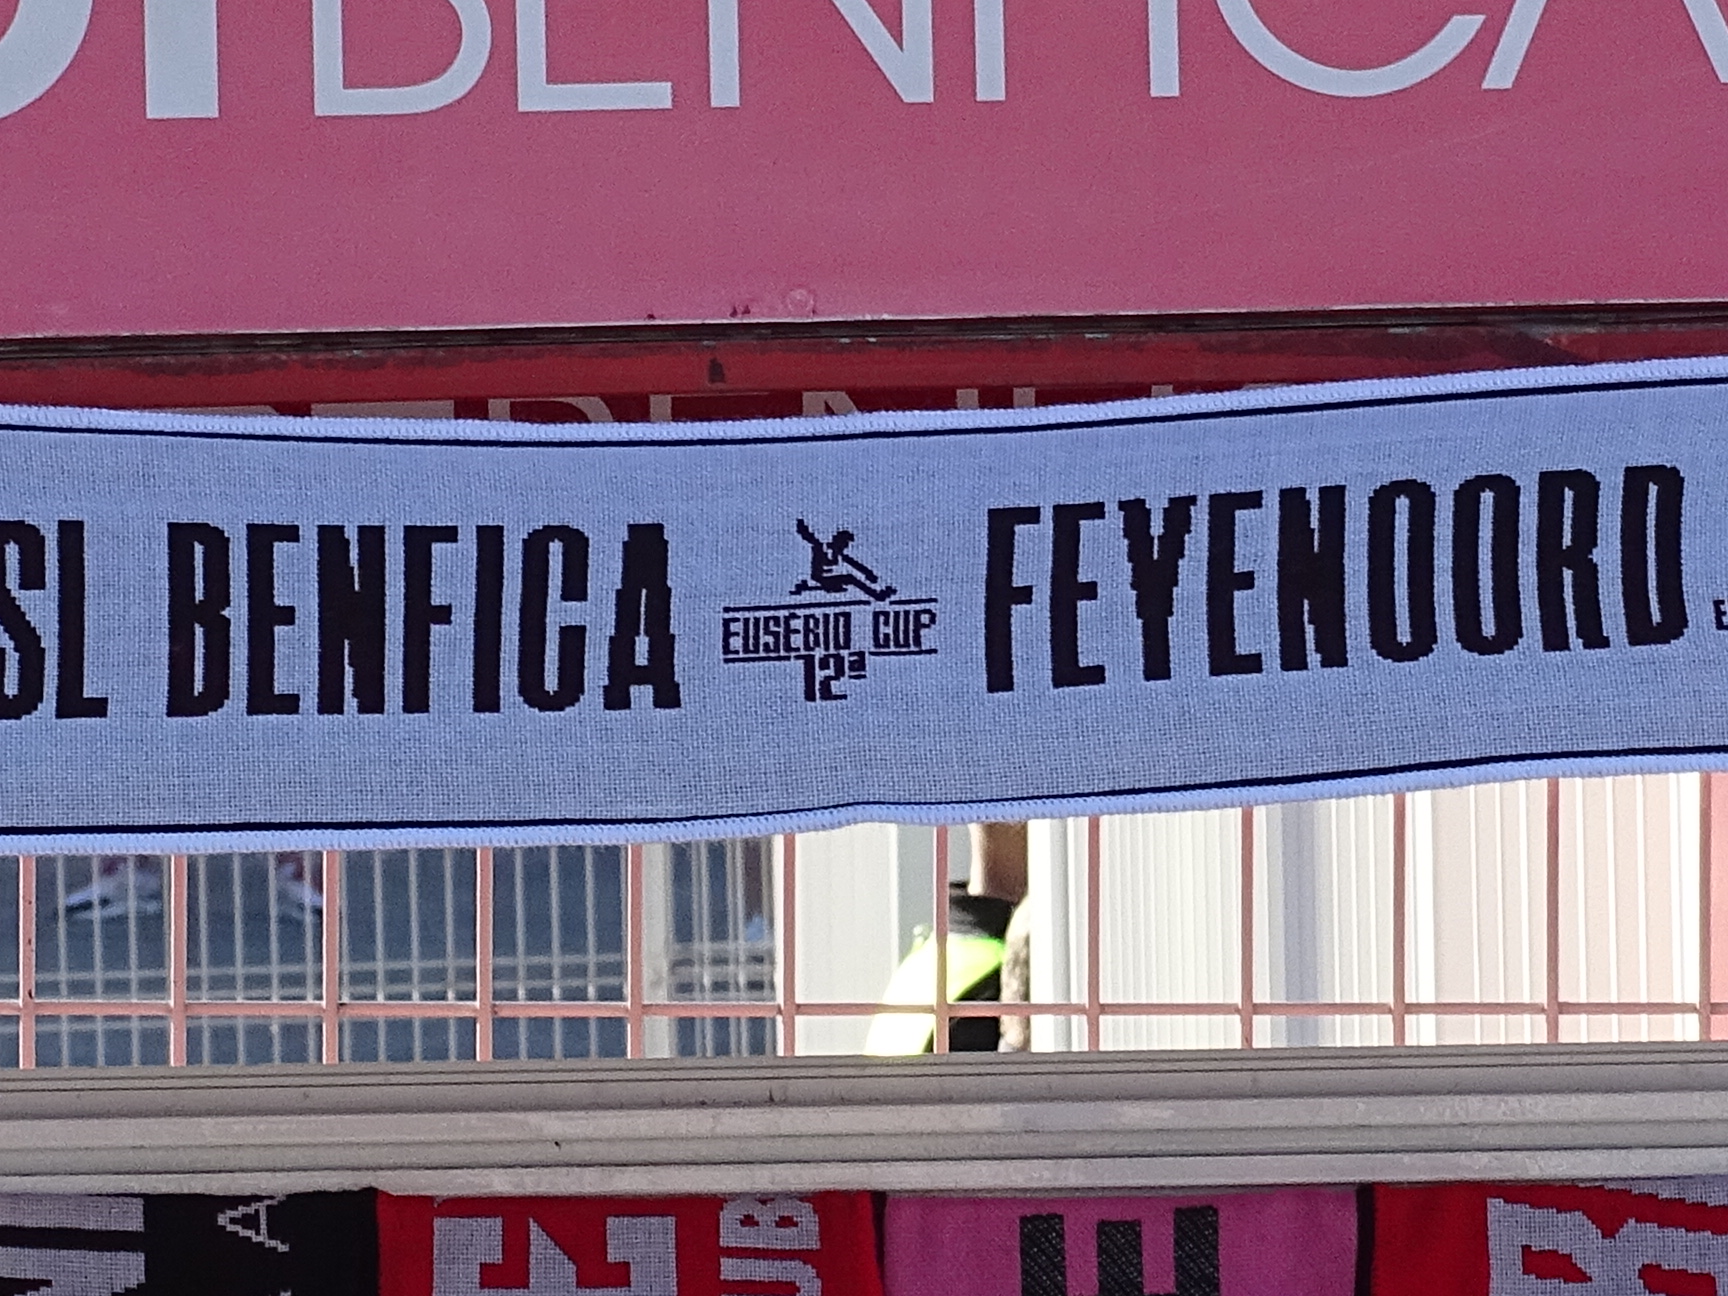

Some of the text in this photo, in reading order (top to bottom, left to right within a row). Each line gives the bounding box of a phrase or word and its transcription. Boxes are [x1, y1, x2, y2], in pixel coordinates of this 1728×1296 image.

[165, 520, 682, 719] BENFICA
[872, 608, 937, 650] CUP
[983, 463, 1688, 693] FEYENOORD
